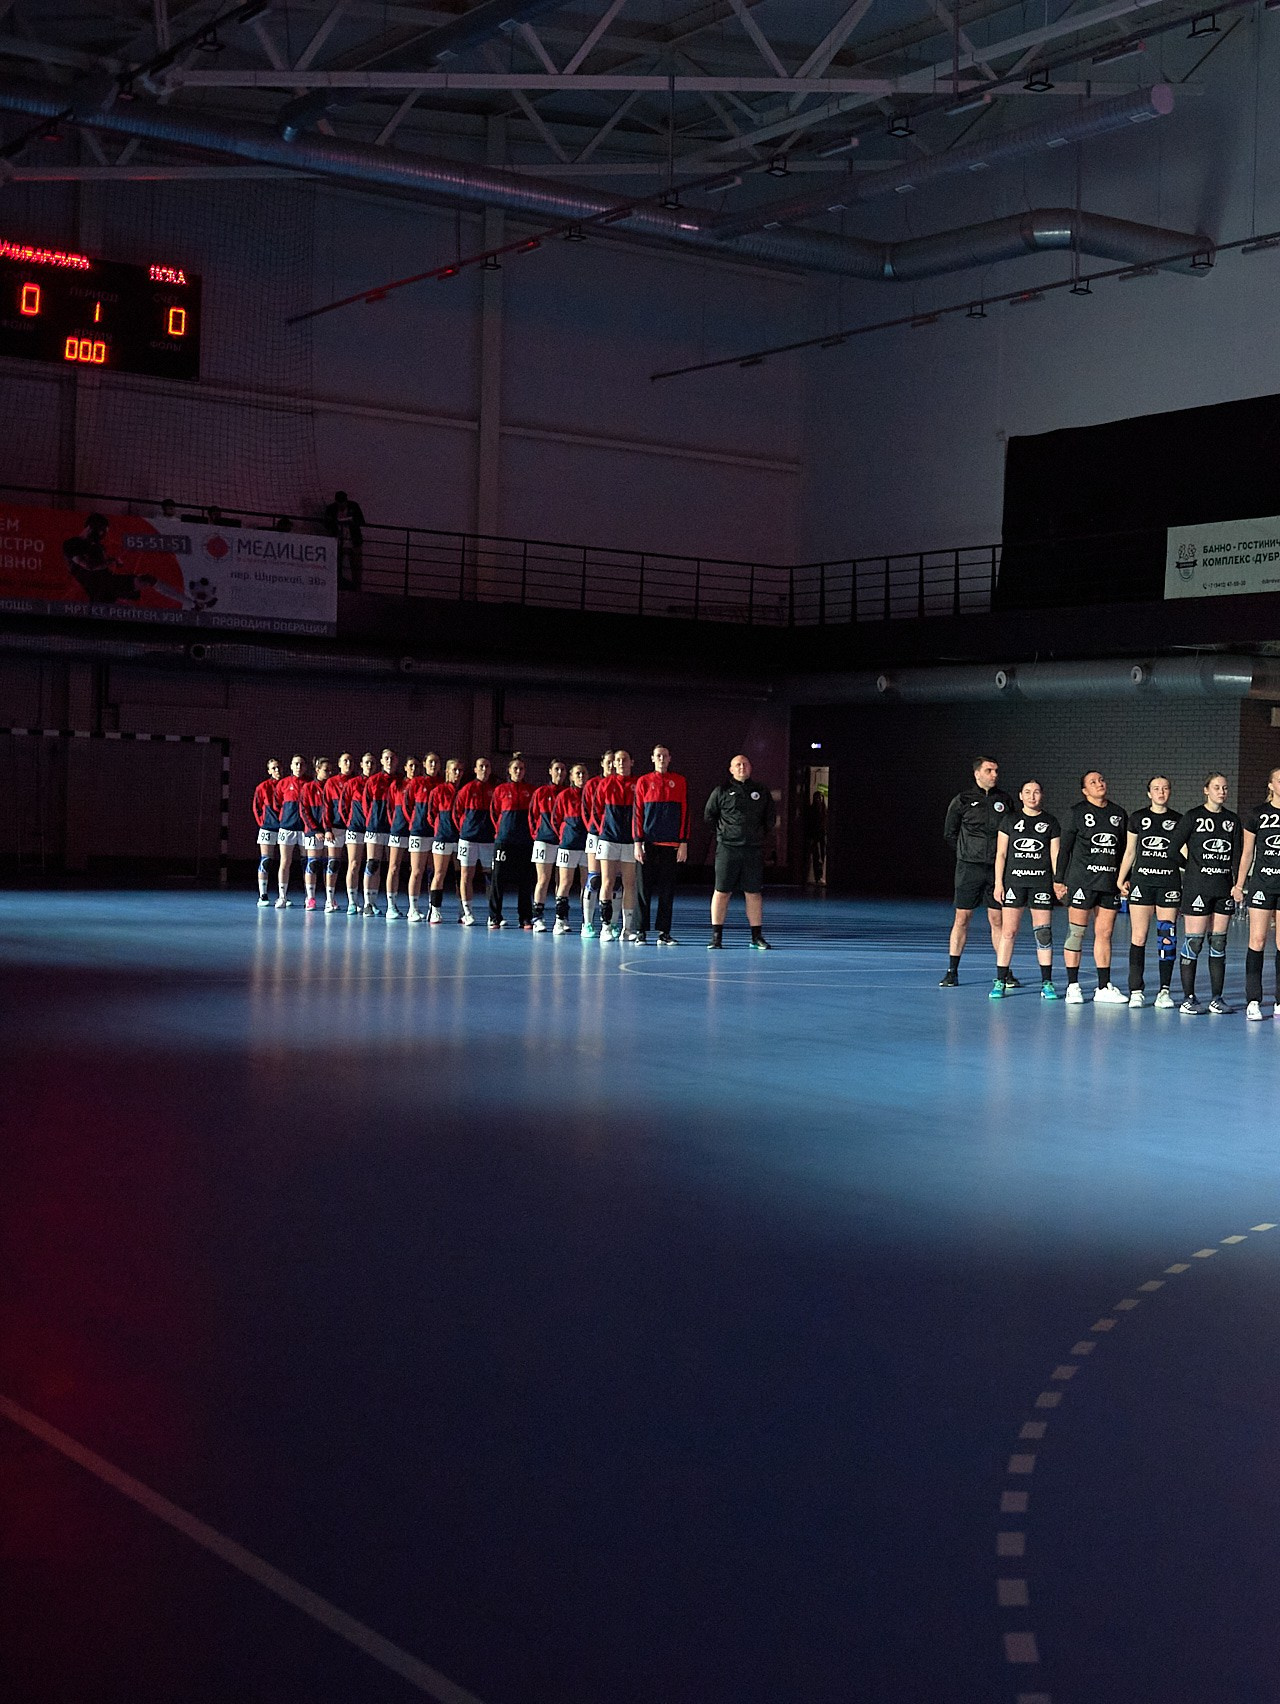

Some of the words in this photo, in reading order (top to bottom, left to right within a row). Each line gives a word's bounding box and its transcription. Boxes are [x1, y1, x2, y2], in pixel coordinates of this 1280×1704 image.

[168, 306, 187, 336] 0
[238, 539, 327, 563] МЕДИЦЕЯ
[1203, 543, 1232, 554] БАННО
[1203, 555, 1251, 567] КОМПЛЕКС
[1013, 819, 1026, 833] 4
[1084, 813, 1096, 828] 8
[1141, 817, 1152, 831] 9
[1195, 817, 1215, 833] 20
[1259, 813, 1280, 829] 22
[410, 838, 420, 849] 25
[434, 841, 446, 851] 23
[588, 838, 593, 848] 8
[495, 849, 507, 862] 16
[535, 848, 545, 860] 14
[1011, 869, 1046, 878] AQUALITY
[1138, 867, 1174, 876] AQUALITY
